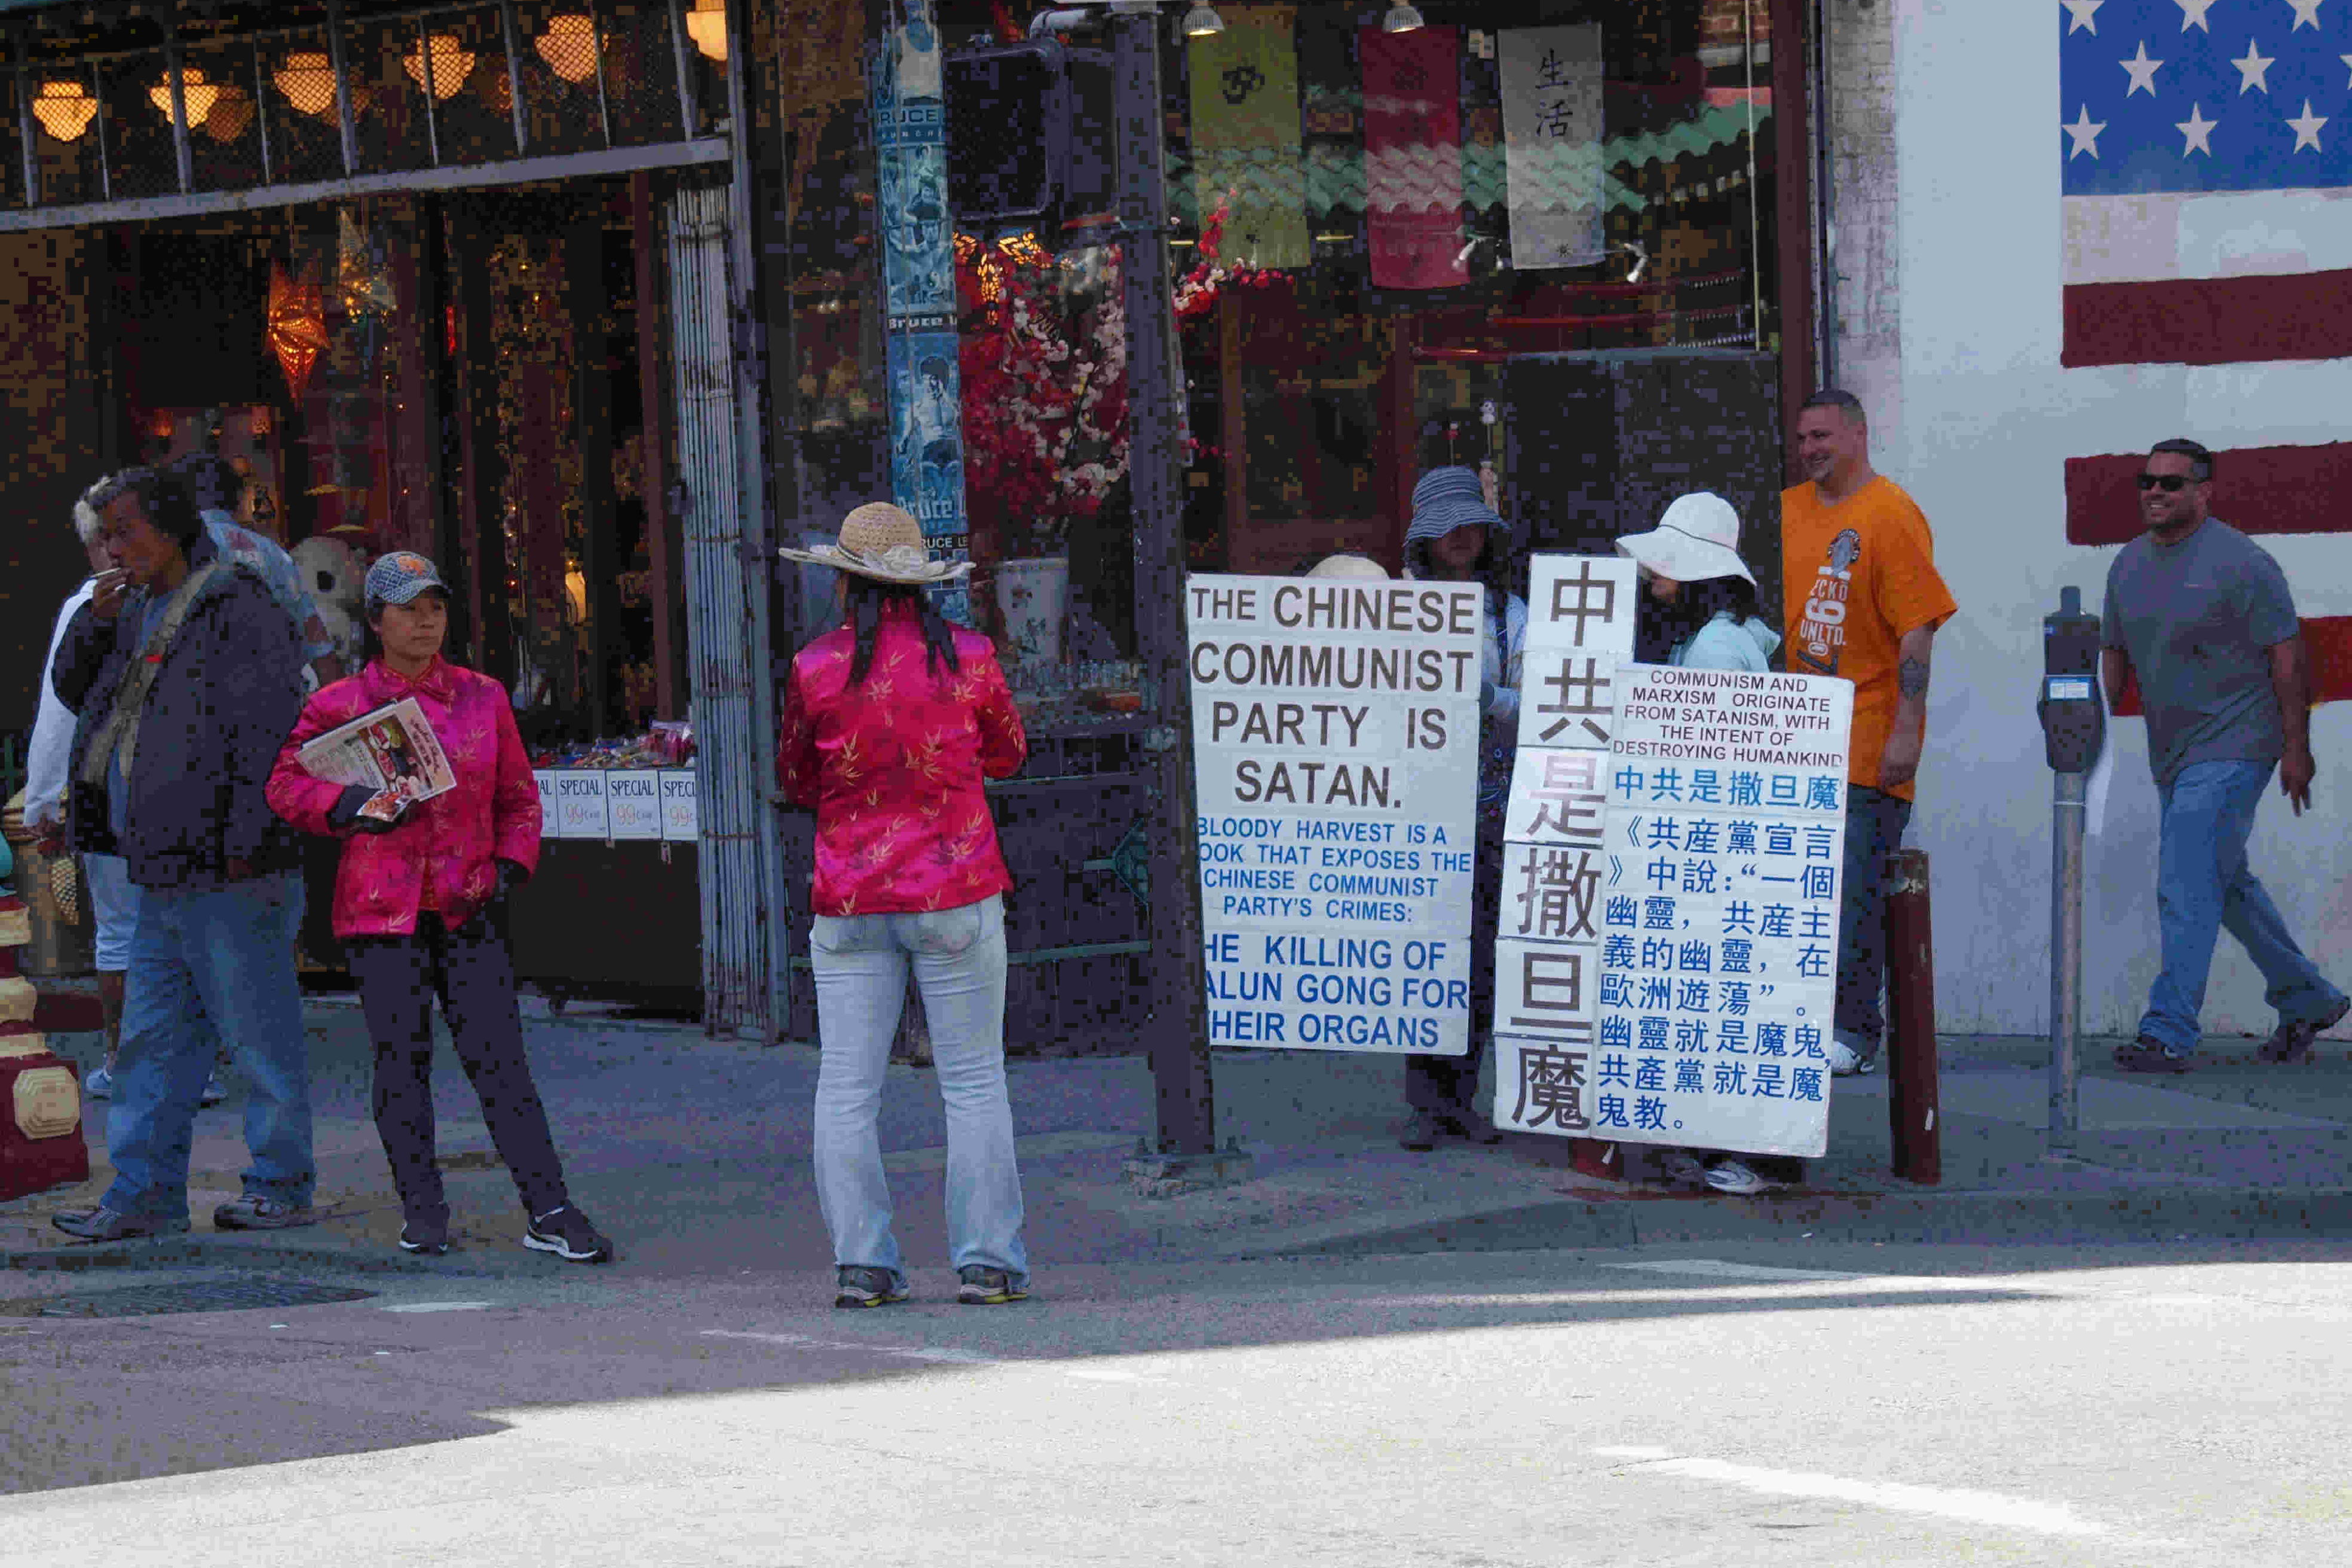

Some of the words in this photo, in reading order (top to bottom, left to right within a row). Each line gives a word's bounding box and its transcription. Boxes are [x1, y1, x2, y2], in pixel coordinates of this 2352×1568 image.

[1191, 587, 1255, 620] THE
[1274, 586, 1475, 635] CHINESE
[1191, 641, 1474, 693] COMMUNIST
[1650, 670, 1765, 690] COMMUNISM
[1770, 678, 1808, 693] AND
[1633, 687, 1716, 705] MARXISM
[1733, 694, 1830, 712] ORIGINATE
[1212, 701, 1370, 748] PARTY
[1407, 708, 1447, 749] IS
[1624, 705, 1676, 721] FROM
[1682, 709, 1778, 729] SATANISM,
[1785, 715, 1830, 730] WITH
[1660, 725, 1693, 740] THE
[1700, 727, 1764, 745] INTENT
[1770, 732, 1793, 746] OF
[1613, 740, 1726, 760] DESTROYING
[1734, 748, 1843, 768] HUMANKIND
[559, 780, 602, 796] SPECIAL
[611, 780, 655, 797] SPECIAL
[664, 780, 696, 798] SPECI
[1235, 760, 1401, 808] SATAN.
[1615, 765, 1840, 811] 中共是撒旦魔
[1198, 817, 1283, 838] BLOODY
[1297, 820, 1395, 842] HARVEST
[1407, 825, 1425, 844] IS
[1432, 826, 1447, 845] A
[1199, 843, 1244, 863] OOK
[1257, 844, 1312, 865] THAT
[1322, 847, 1420, 869] EXPOSES
[1431, 852, 1471, 872] THE
[1511, 561, 1615, 1131] 中共是撒旦魔
[1204, 869, 1295, 889] CHINESE
[1309, 873, 1439, 897] COMMUNIST
[1224, 896, 1312, 917] PARTY'S
[1326, 899, 1412, 923] CRIMES:
[1205, 933, 1239, 963] HE
[1265, 935, 1392, 969] KILLING
[1404, 941, 1447, 971] OF
[1205, 970, 1282, 1001] ALUN
[1297, 974, 1392, 1006] GONG
[1402, 978, 1468, 1009] FOR
[1209, 1010, 1285, 1041] HEIR
[1298, 1013, 1439, 1047] ORGANS
